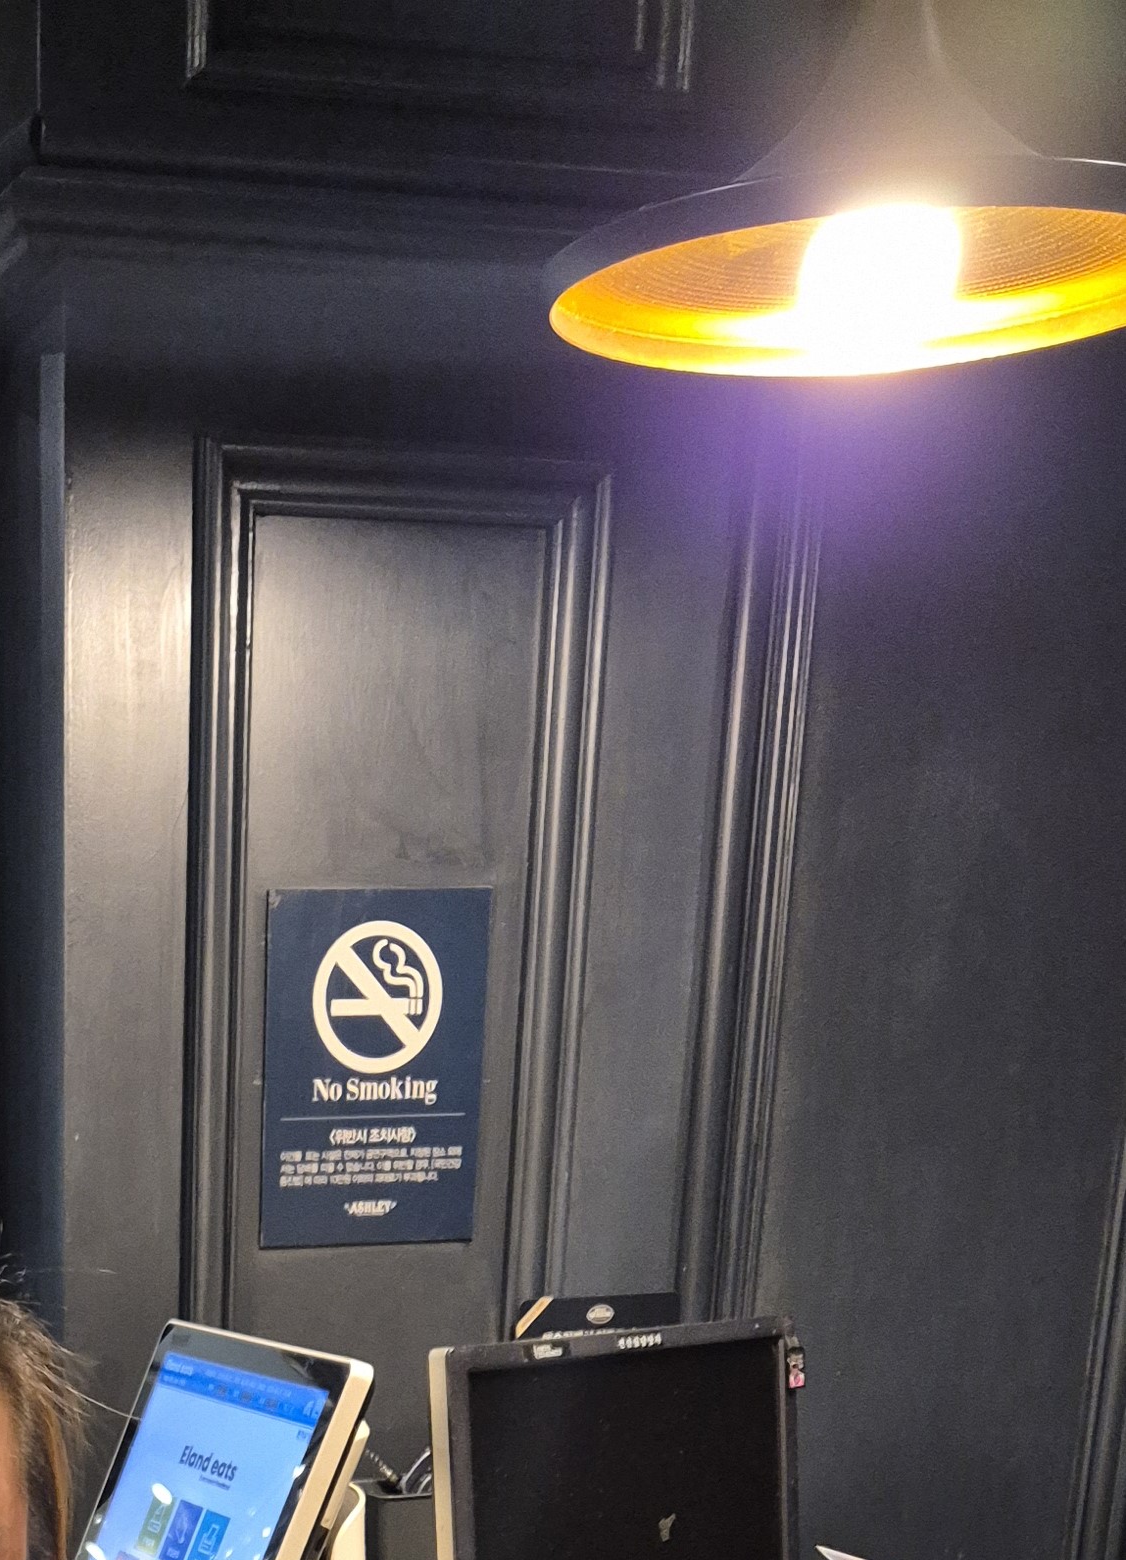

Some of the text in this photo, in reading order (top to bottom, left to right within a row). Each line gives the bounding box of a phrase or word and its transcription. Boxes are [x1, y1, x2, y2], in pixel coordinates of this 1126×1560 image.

[312, 1076, 439, 1106] No Smoking
[178, 1445, 238, 1482] Eland eats
